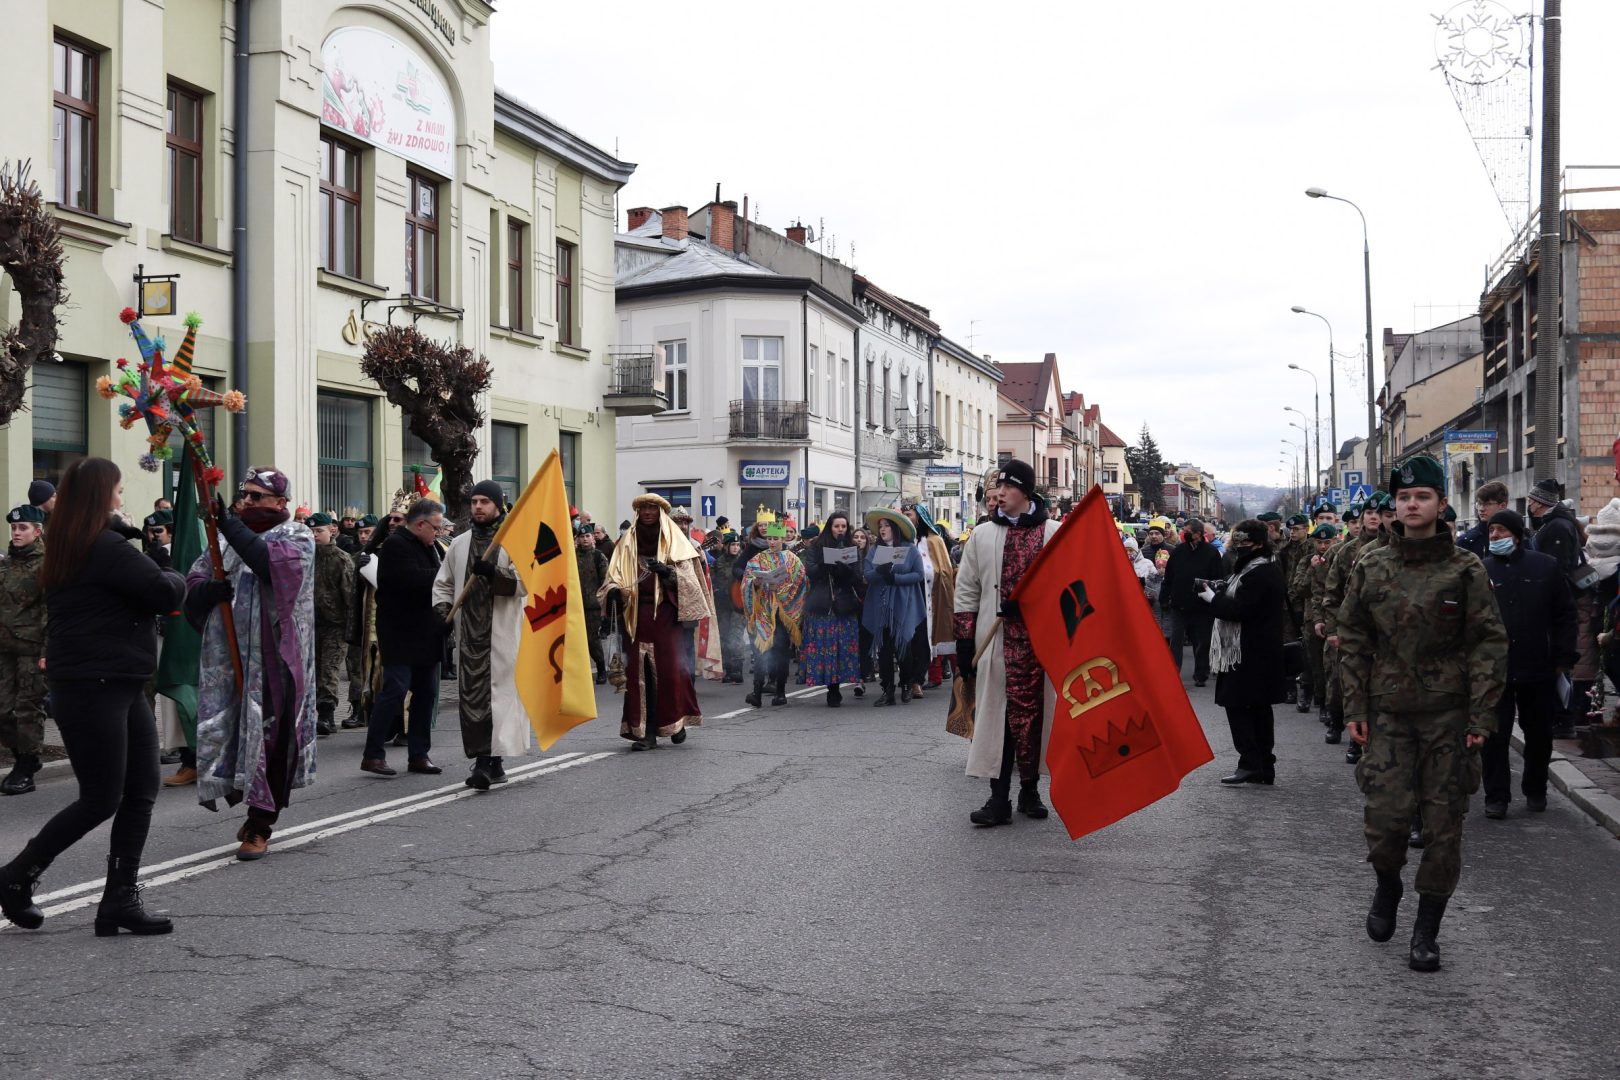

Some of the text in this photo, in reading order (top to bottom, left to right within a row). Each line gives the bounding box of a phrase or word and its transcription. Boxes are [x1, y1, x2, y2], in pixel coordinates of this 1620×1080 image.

[416, 119, 446, 136] Z NAMI
[387, 128, 403, 146] ŻYJ
[405, 134, 445, 153] ZDROWO
[755, 467, 785, 475] APTEKA
[1349, 474, 1360, 487] P
[1332, 490, 1341, 502] P
